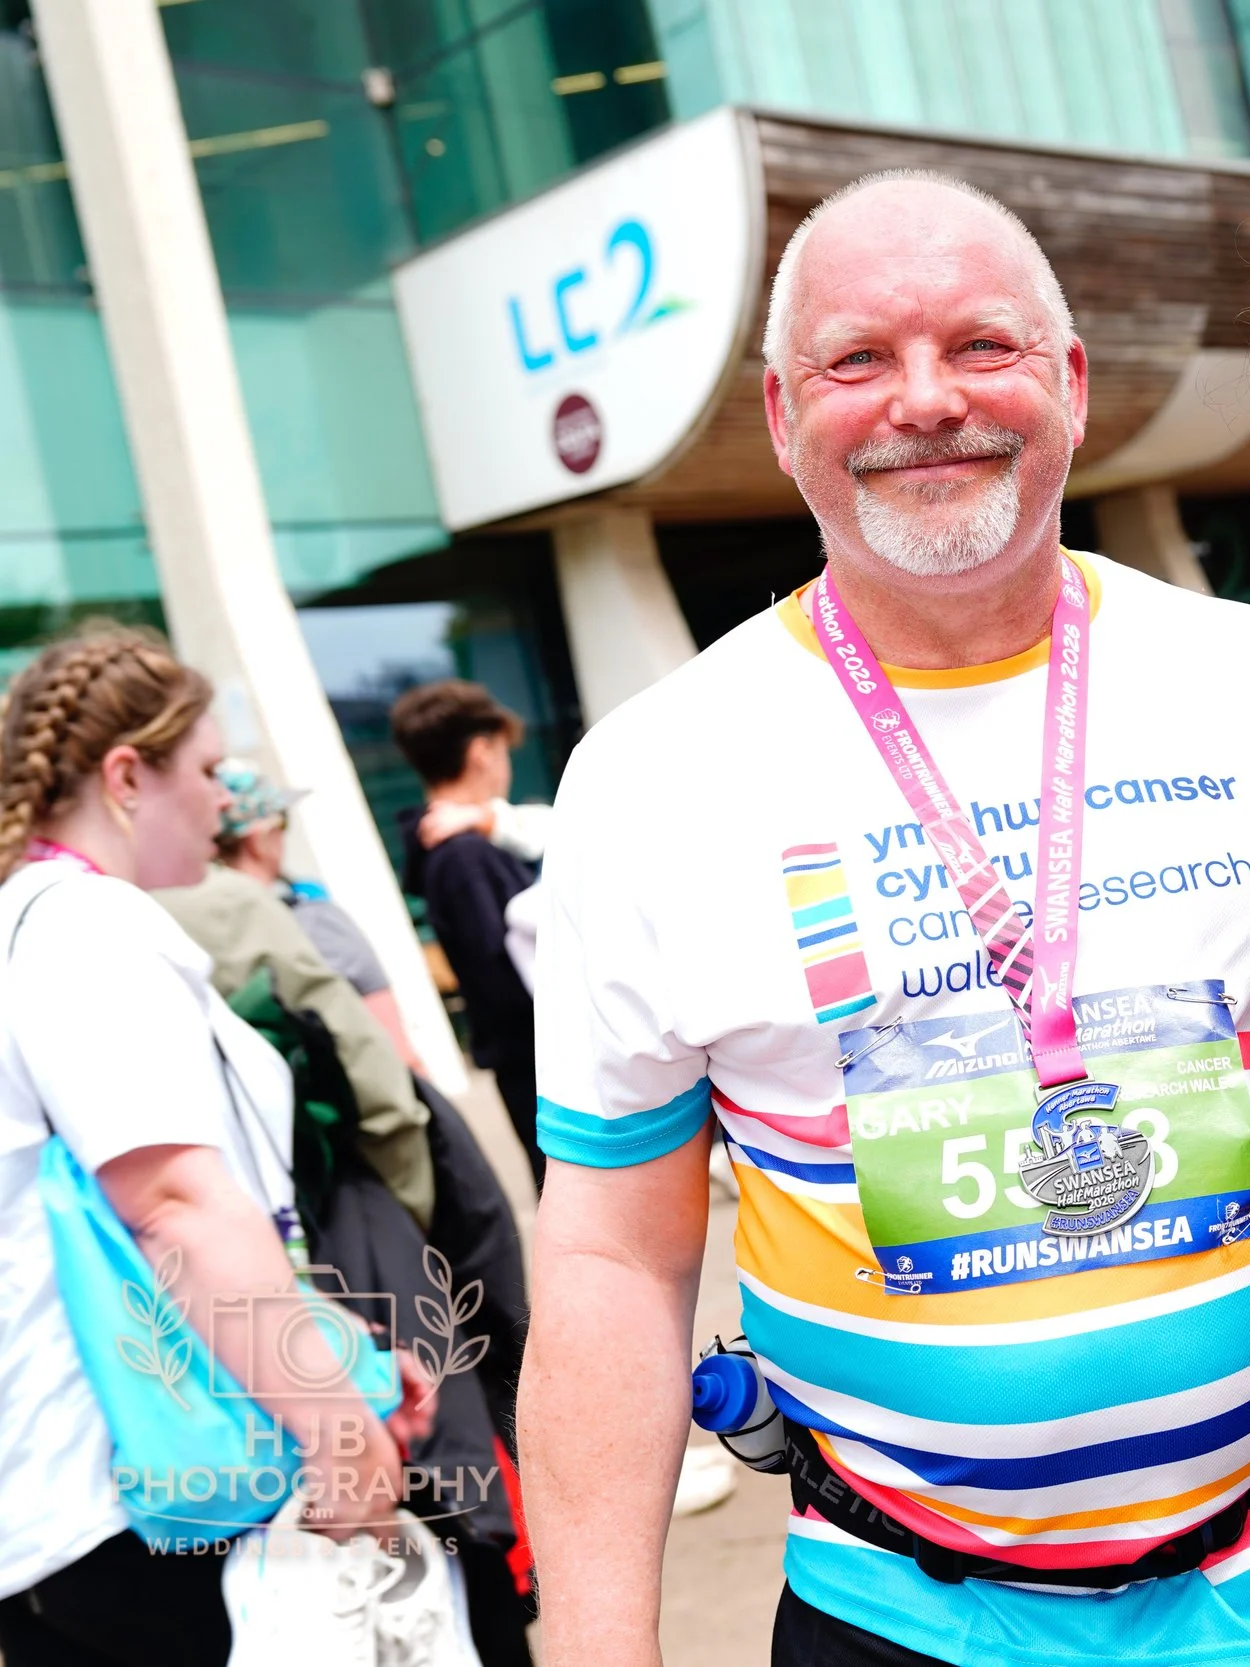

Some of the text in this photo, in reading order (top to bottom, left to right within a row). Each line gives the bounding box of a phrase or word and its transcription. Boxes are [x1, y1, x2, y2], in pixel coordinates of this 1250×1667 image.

[508, 217, 690, 372] LC2
[836, 643, 877, 695] 2026
[893, 729, 951, 819] FRONTRUNNER
[1044, 623, 1081, 944] SWANSEA Half Marathon 2026
[1084, 775, 1236, 810] canser
[902, 949, 1003, 998] wale
[1111, 1034, 1157, 1048] ABERTAWE
[1177, 1056, 1232, 1075] CANCER
[1058, 1096, 1096, 1113] Abertawe
[1071, 1085, 1110, 1098] Marathon
[856, 1093, 974, 1141] GARY
[940, 1107, 1179, 1219] 558
[1053, 1160, 1137, 1195] SWANSEA
[1051, 1188, 1139, 1231] #RUNSWANSEA
[1087, 1194, 1115, 1212] 2026
[951, 1215, 1194, 1281] #RUNSWANSEA
